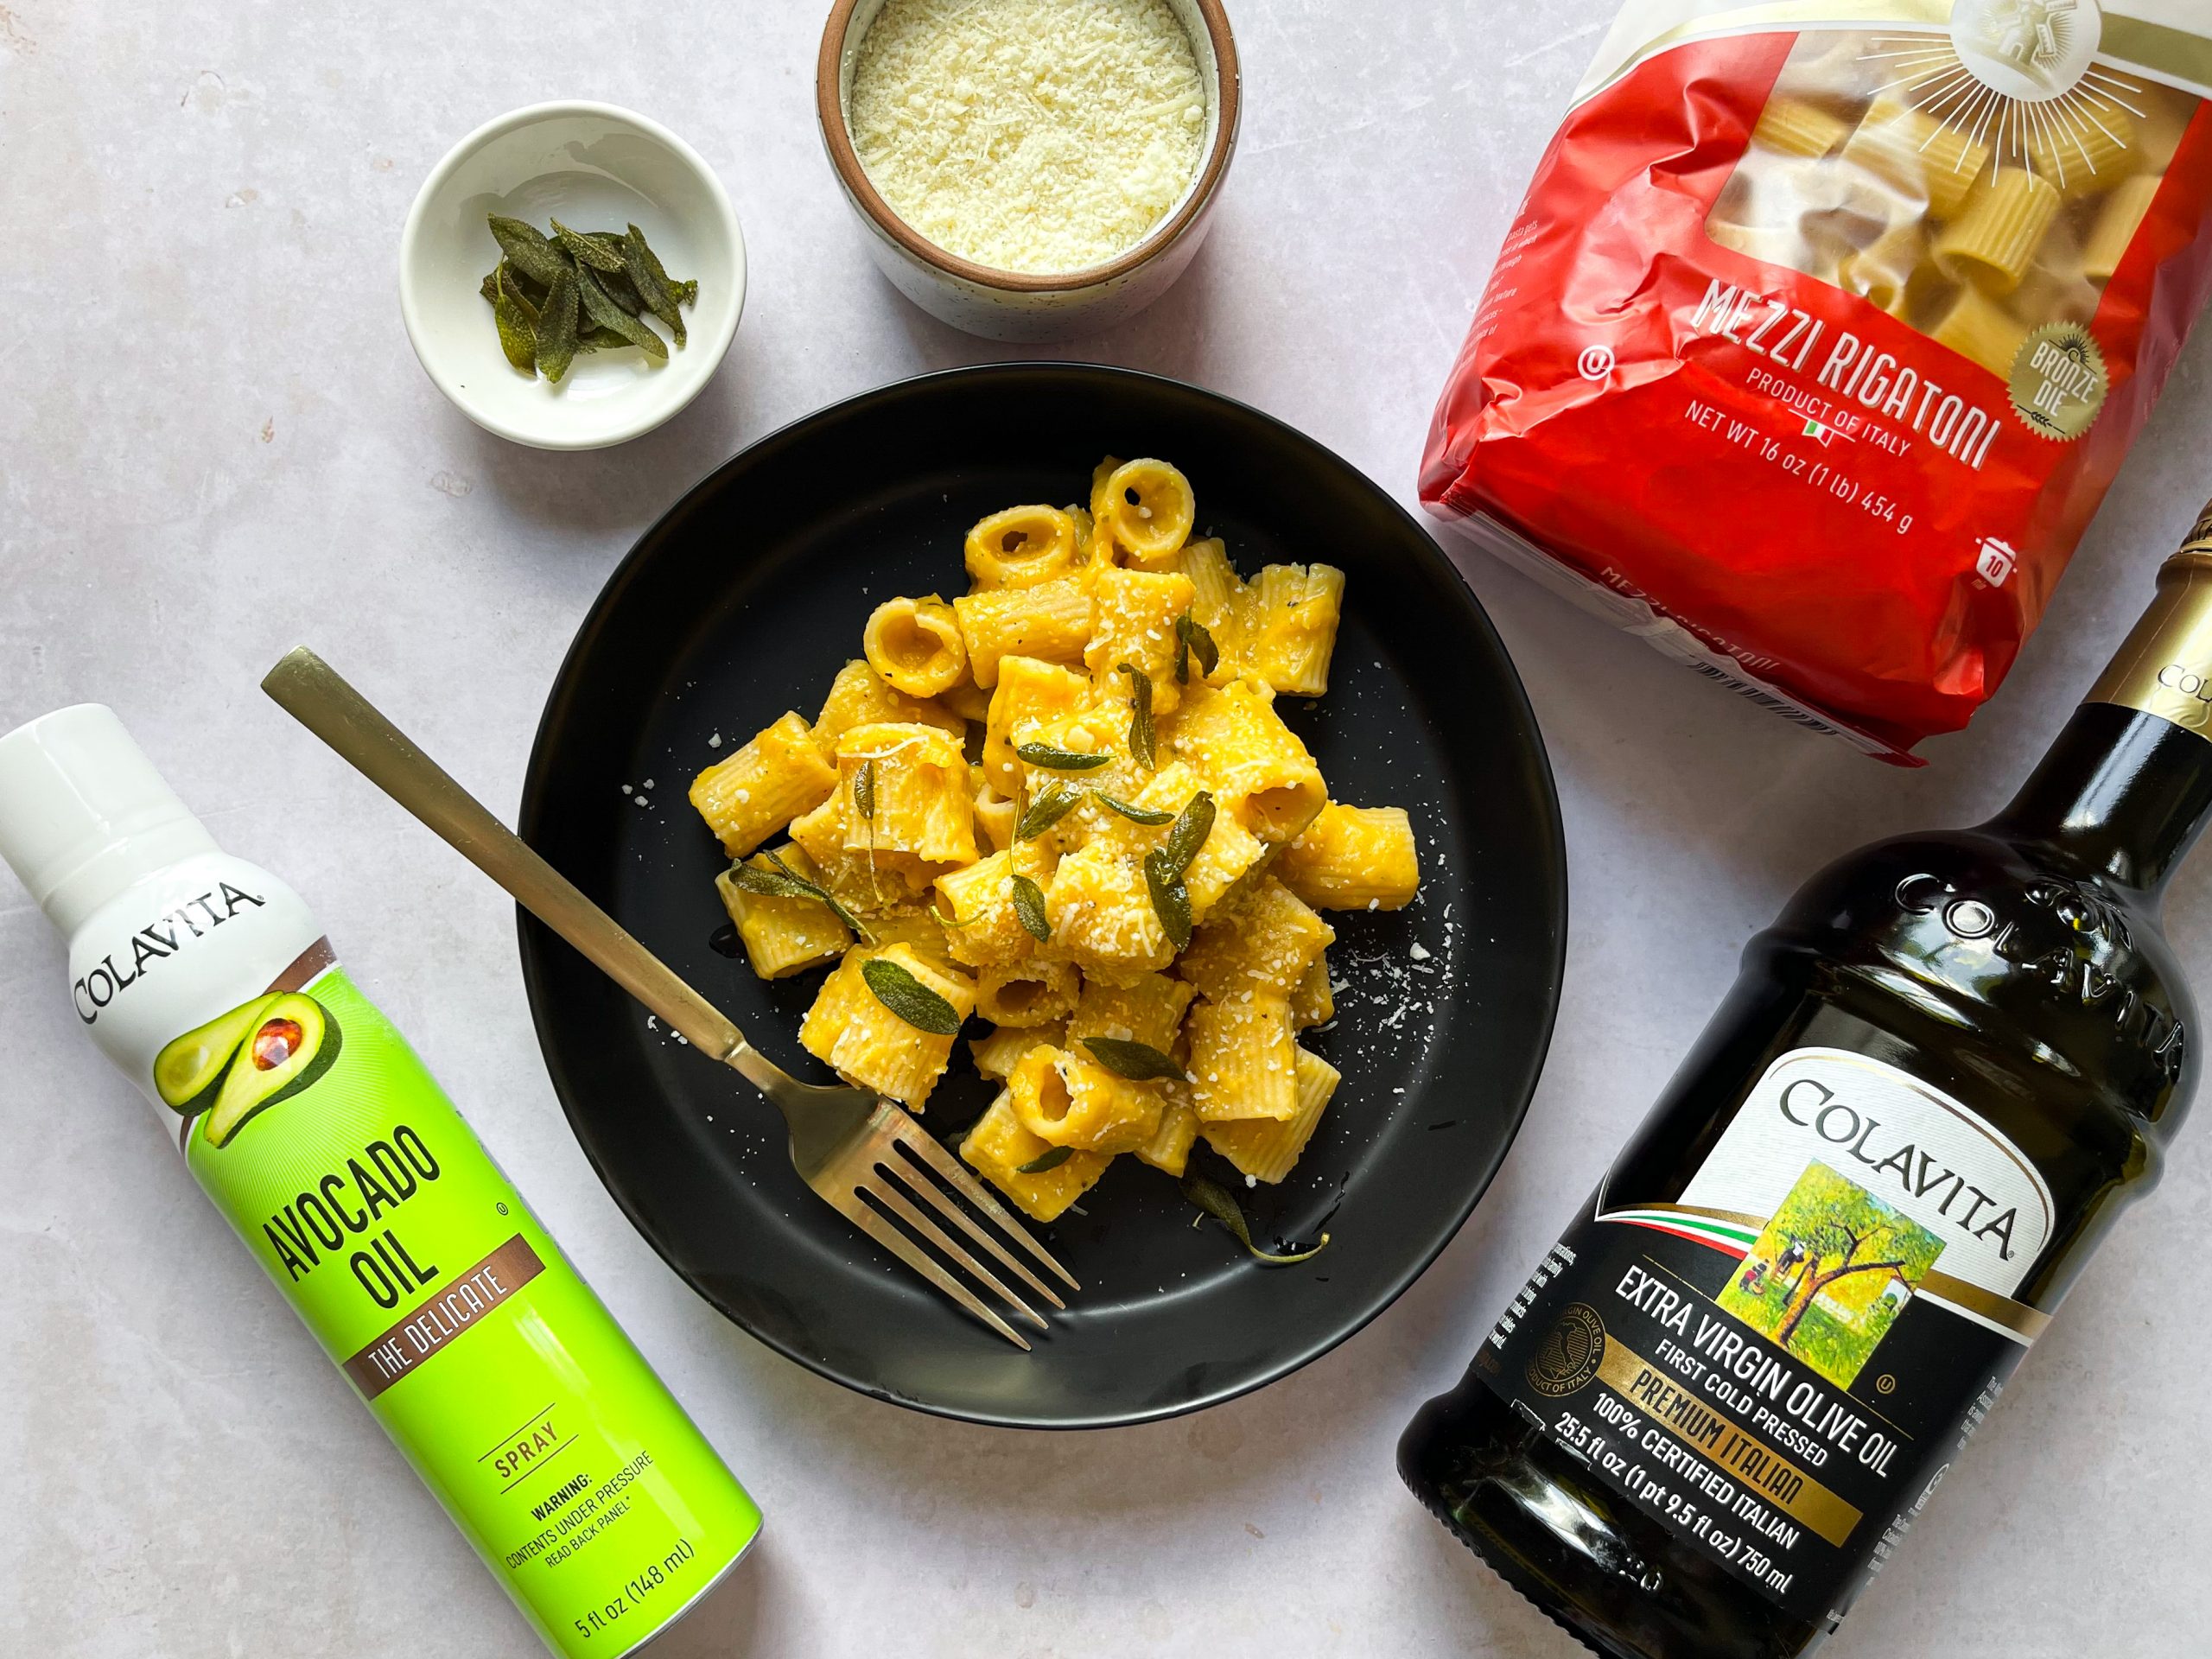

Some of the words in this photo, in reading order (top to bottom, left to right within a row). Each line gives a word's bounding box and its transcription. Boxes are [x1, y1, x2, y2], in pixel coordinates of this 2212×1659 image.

[1691, 278, 1825, 372] MEZZI
[1817, 332, 2001, 470] RIGATONI
[1746, 368, 1833, 420] PRODUCT
[1834, 410, 1859, 432] OF
[1861, 423, 1911, 458] ITALY
[2030, 341, 2099, 404] BRONZE
[2033, 379, 2068, 417] DIE
[1685, 399, 1727, 432] NET
[1726, 419, 1759, 449] WT
[1759, 437, 1779, 461] 16
[1782, 454, 1808, 476] oz
[1808, 463, 1830, 488] (1
[1828, 475, 1859, 505] lb)
[1860, 491, 1894, 523] 454
[1896, 514, 1914, 535] g
[1986, 555, 2004, 578] 10
[262, 1125, 441, 1283] AVOCADO
[349, 1228, 440, 1309] OIL
[368, 1337, 412, 1380] THE
[404, 1265, 507, 1354] DELICATE
[1582, 1310, 1601, 1336] OLIVE
[1592, 1337, 1602, 1354] OIL
[1614, 1265, 1694, 1337] EXTRA
[1694, 1314, 1792, 1400] VIRGIN
[1785, 1382, 1866, 1452] OLIVE
[1858, 1433, 1897, 1478] OIL
[1552, 1383, 1566, 1393] OF
[1567, 1365, 1592, 1389] ITALY
[1655, 1338, 1707, 1380] FIRST
[1704, 1373, 1753, 1415] COLD
[1751, 1406, 1827, 1467] PRESSED
[495, 1421, 557, 1478] SPRAY
[1592, 1392, 1642, 1440] 100%
[1640, 1428, 1736, 1504] CERTIFIED
[1732, 1493, 1800, 1551] ITALIAN
[1629, 1369, 1725, 1450] PREMIUM
[1720, 1433, 1804, 1505] ITALIAN
[505, 1529, 557, 1569] CONTENTS
[555, 1499, 599, 1535] UNDER
[595, 1451, 653, 1504] PRESSURE
[531, 1472, 593, 1522] WARNING:
[545, 1545, 571, 1568] READ
[569, 1523, 600, 1551] BACK
[1554, 1411, 1592, 1447] 25.5
[1586, 1437, 1603, 1460] fl
[1602, 1452, 1628, 1477] oz
[1624, 1465, 1646, 1490] (1
[1639, 1477, 1667, 1506] pt
[1665, 1493, 1697, 1526] 9.5
[1691, 1515, 1709, 1539] fl
[1708, 1531, 1742, 1559] oz)
[1737, 1545, 1770, 1578] 750
[1765, 1565, 1794, 1595] ml
[575, 1619, 591, 1638] 5
[588, 1610, 607, 1630] fl
[605, 1598, 628, 1620] oz
[625, 1565, 664, 1604] (148
[664, 1538, 696, 1574] ml)
